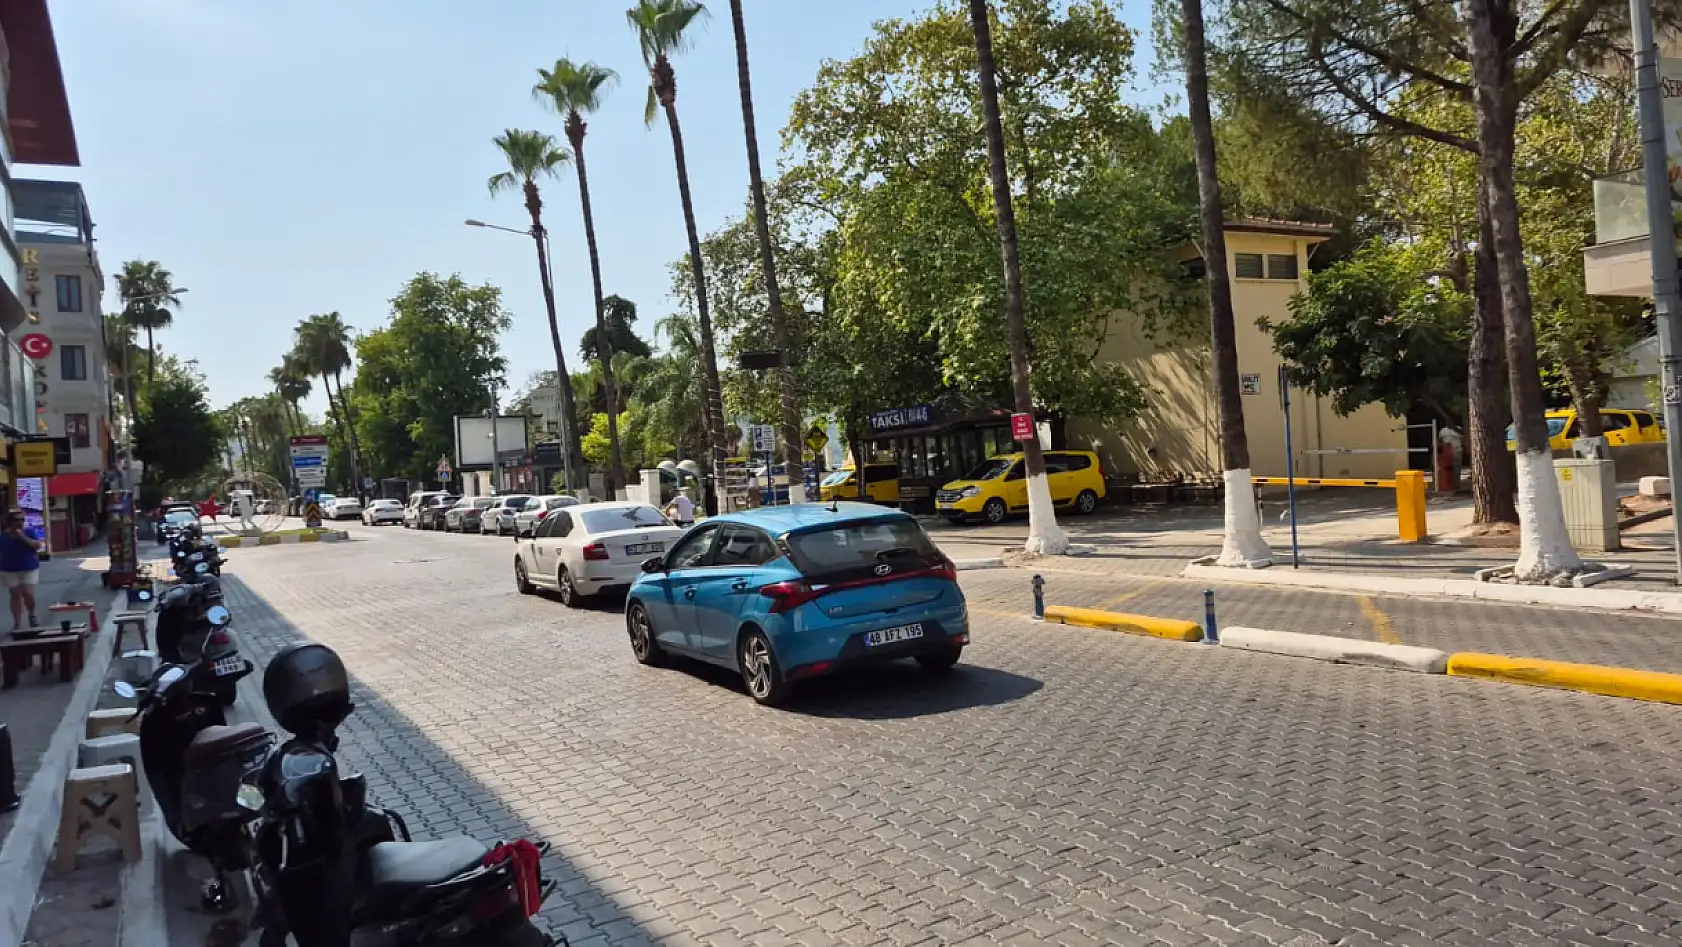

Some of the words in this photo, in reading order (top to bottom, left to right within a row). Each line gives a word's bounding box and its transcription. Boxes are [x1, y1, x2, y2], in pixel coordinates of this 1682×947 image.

[870, 631, 882, 645] 48
[885, 627, 902, 642] AFZ
[905, 623, 923, 638] 195
